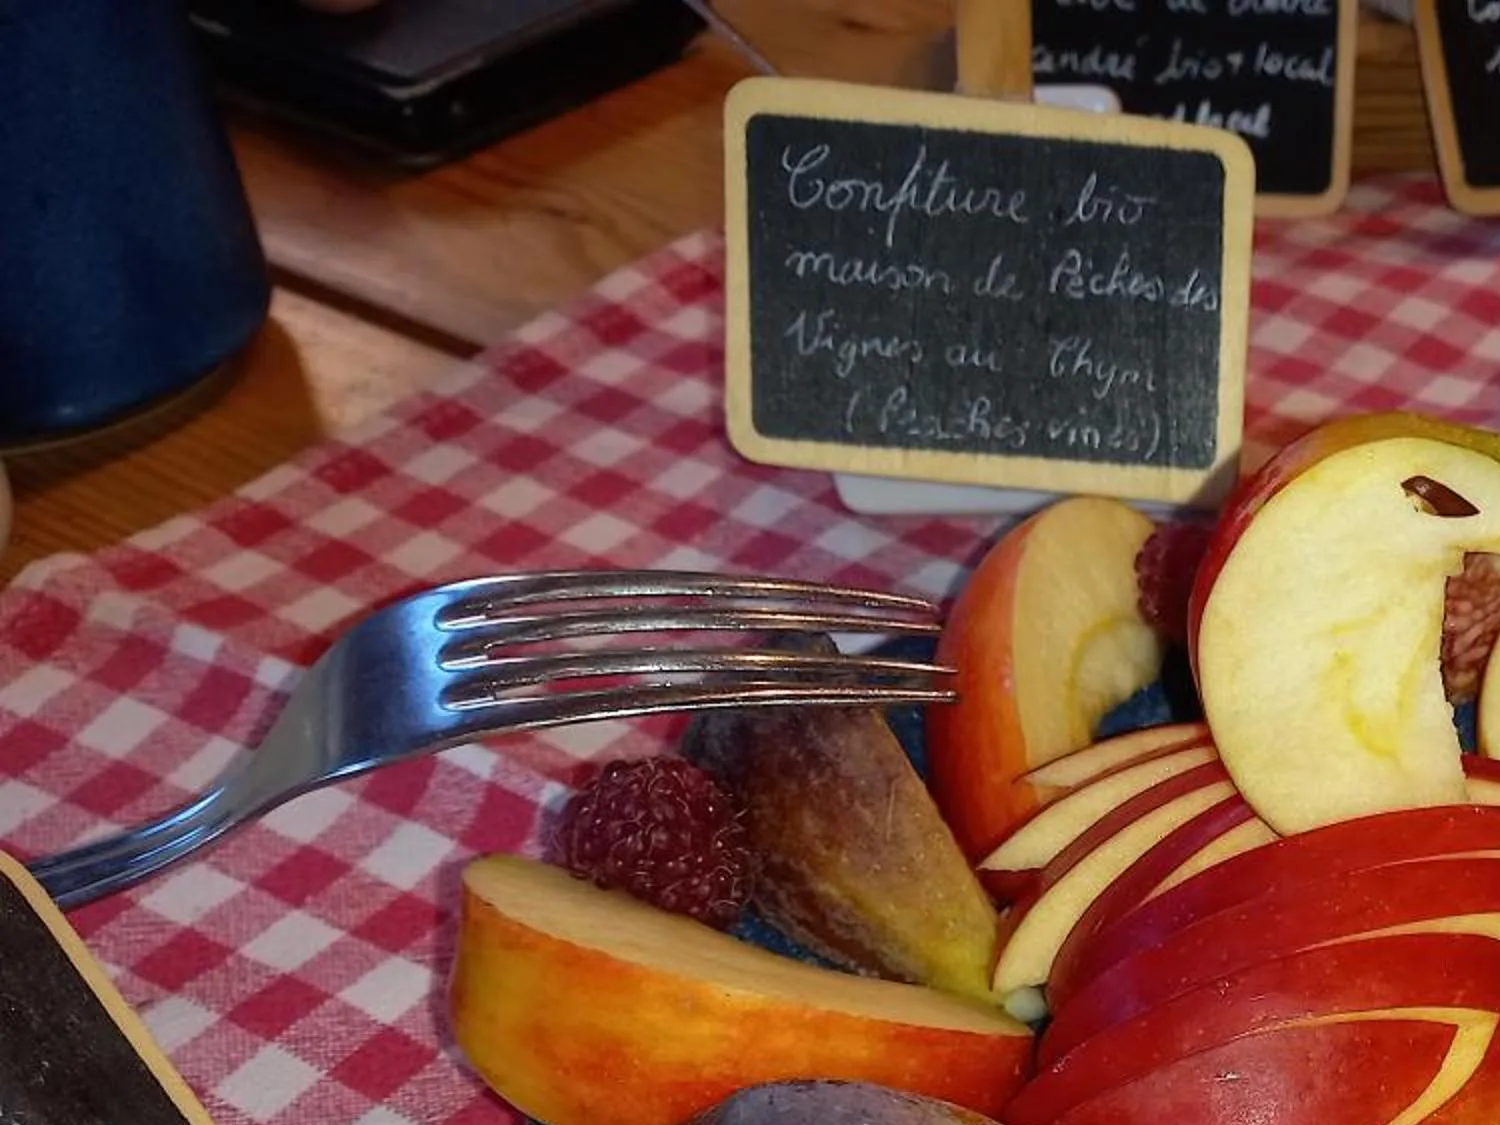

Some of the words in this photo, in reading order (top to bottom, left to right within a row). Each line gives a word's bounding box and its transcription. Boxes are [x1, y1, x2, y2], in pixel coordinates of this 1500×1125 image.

[782, 143, 1029, 247] Confiture
[1066, 172, 1157, 226] bio
[785, 248, 951, 295] maison
[974, 255, 1023, 300] de
[1170, 272, 1218, 313] des
[784, 308, 924, 378] Vignes
[945, 346, 1001, 371] au
